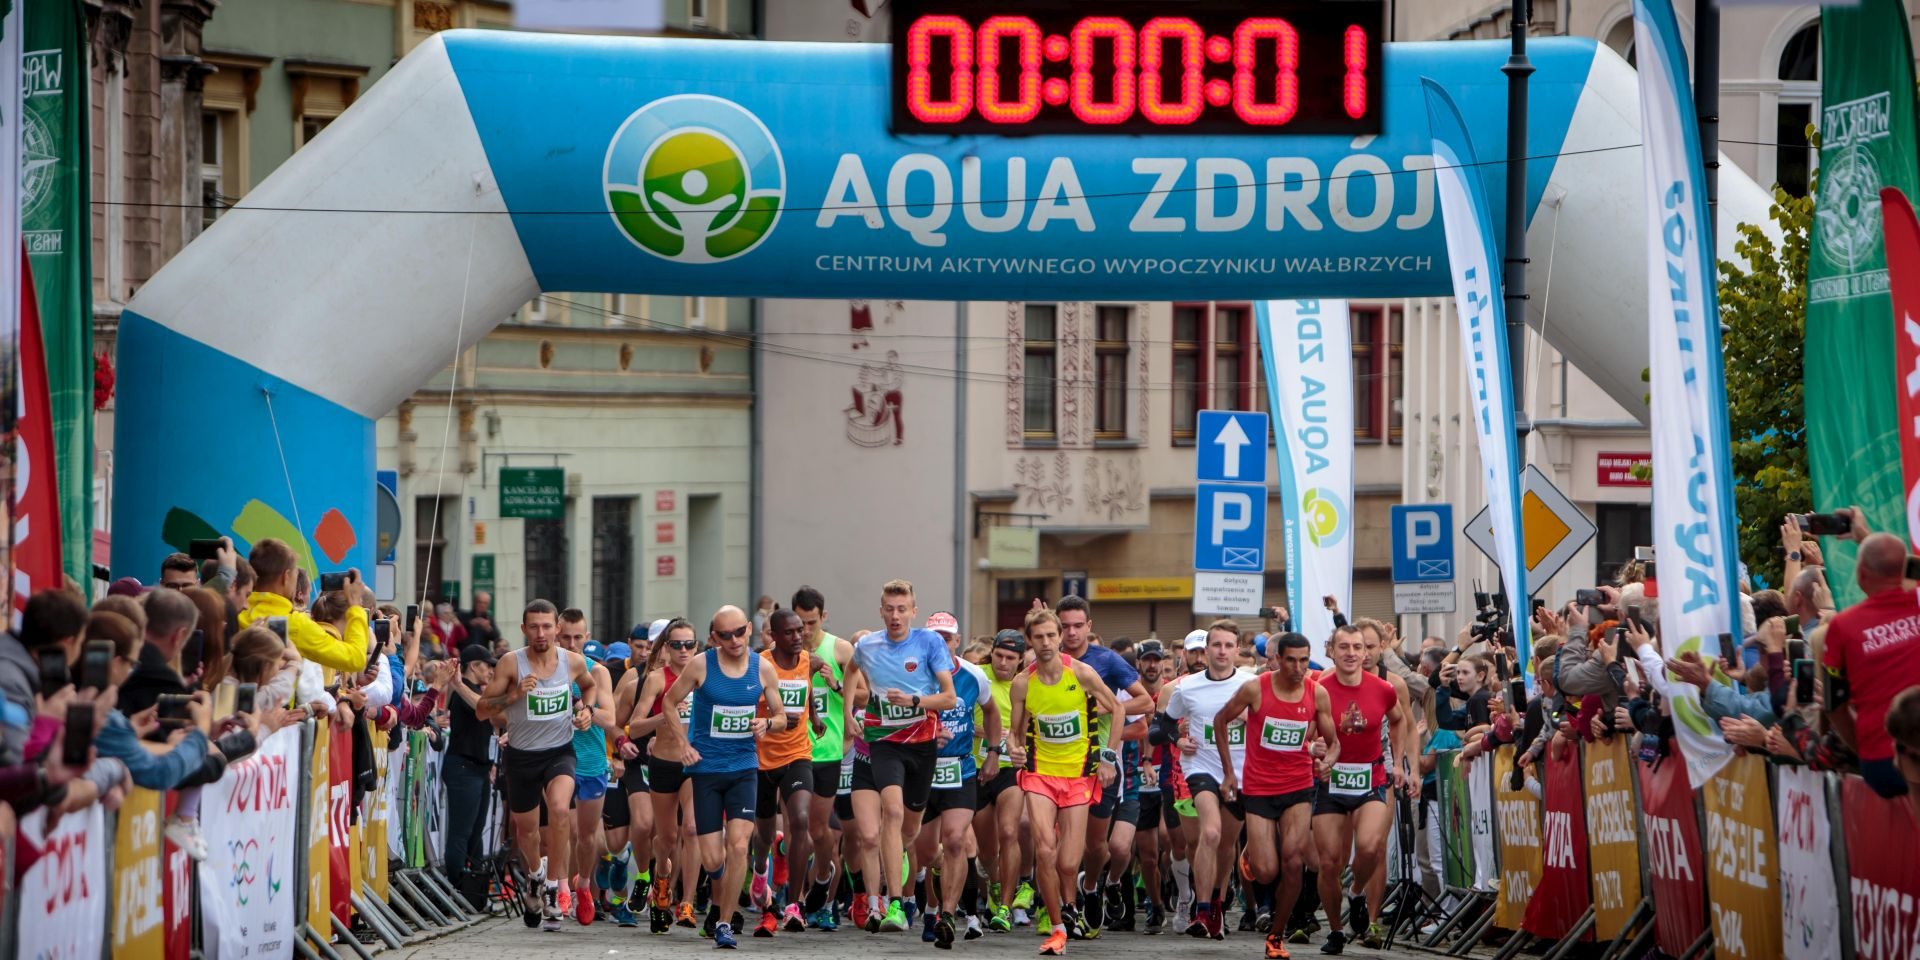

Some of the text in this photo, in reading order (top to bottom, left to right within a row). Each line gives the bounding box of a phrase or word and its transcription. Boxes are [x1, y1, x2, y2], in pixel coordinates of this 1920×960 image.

[816, 135, 1436, 246] AQUA ZDRÓJ
[816, 255, 1432, 274] CENTRUM AKTYWNEGO WYPOCZYNKU WAŁBRZYCH
[503, 485, 560, 495] KANCELARIA
[1211, 491, 1252, 545] P
[1405, 511, 1440, 559] P
[536, 696, 566, 713] 1157
[783, 690, 801, 705] 121
[721, 717, 750, 731] 839
[1046, 722, 1074, 736] 120
[1271, 729, 1301, 744] 838
[1337, 774, 1366, 788] 940
